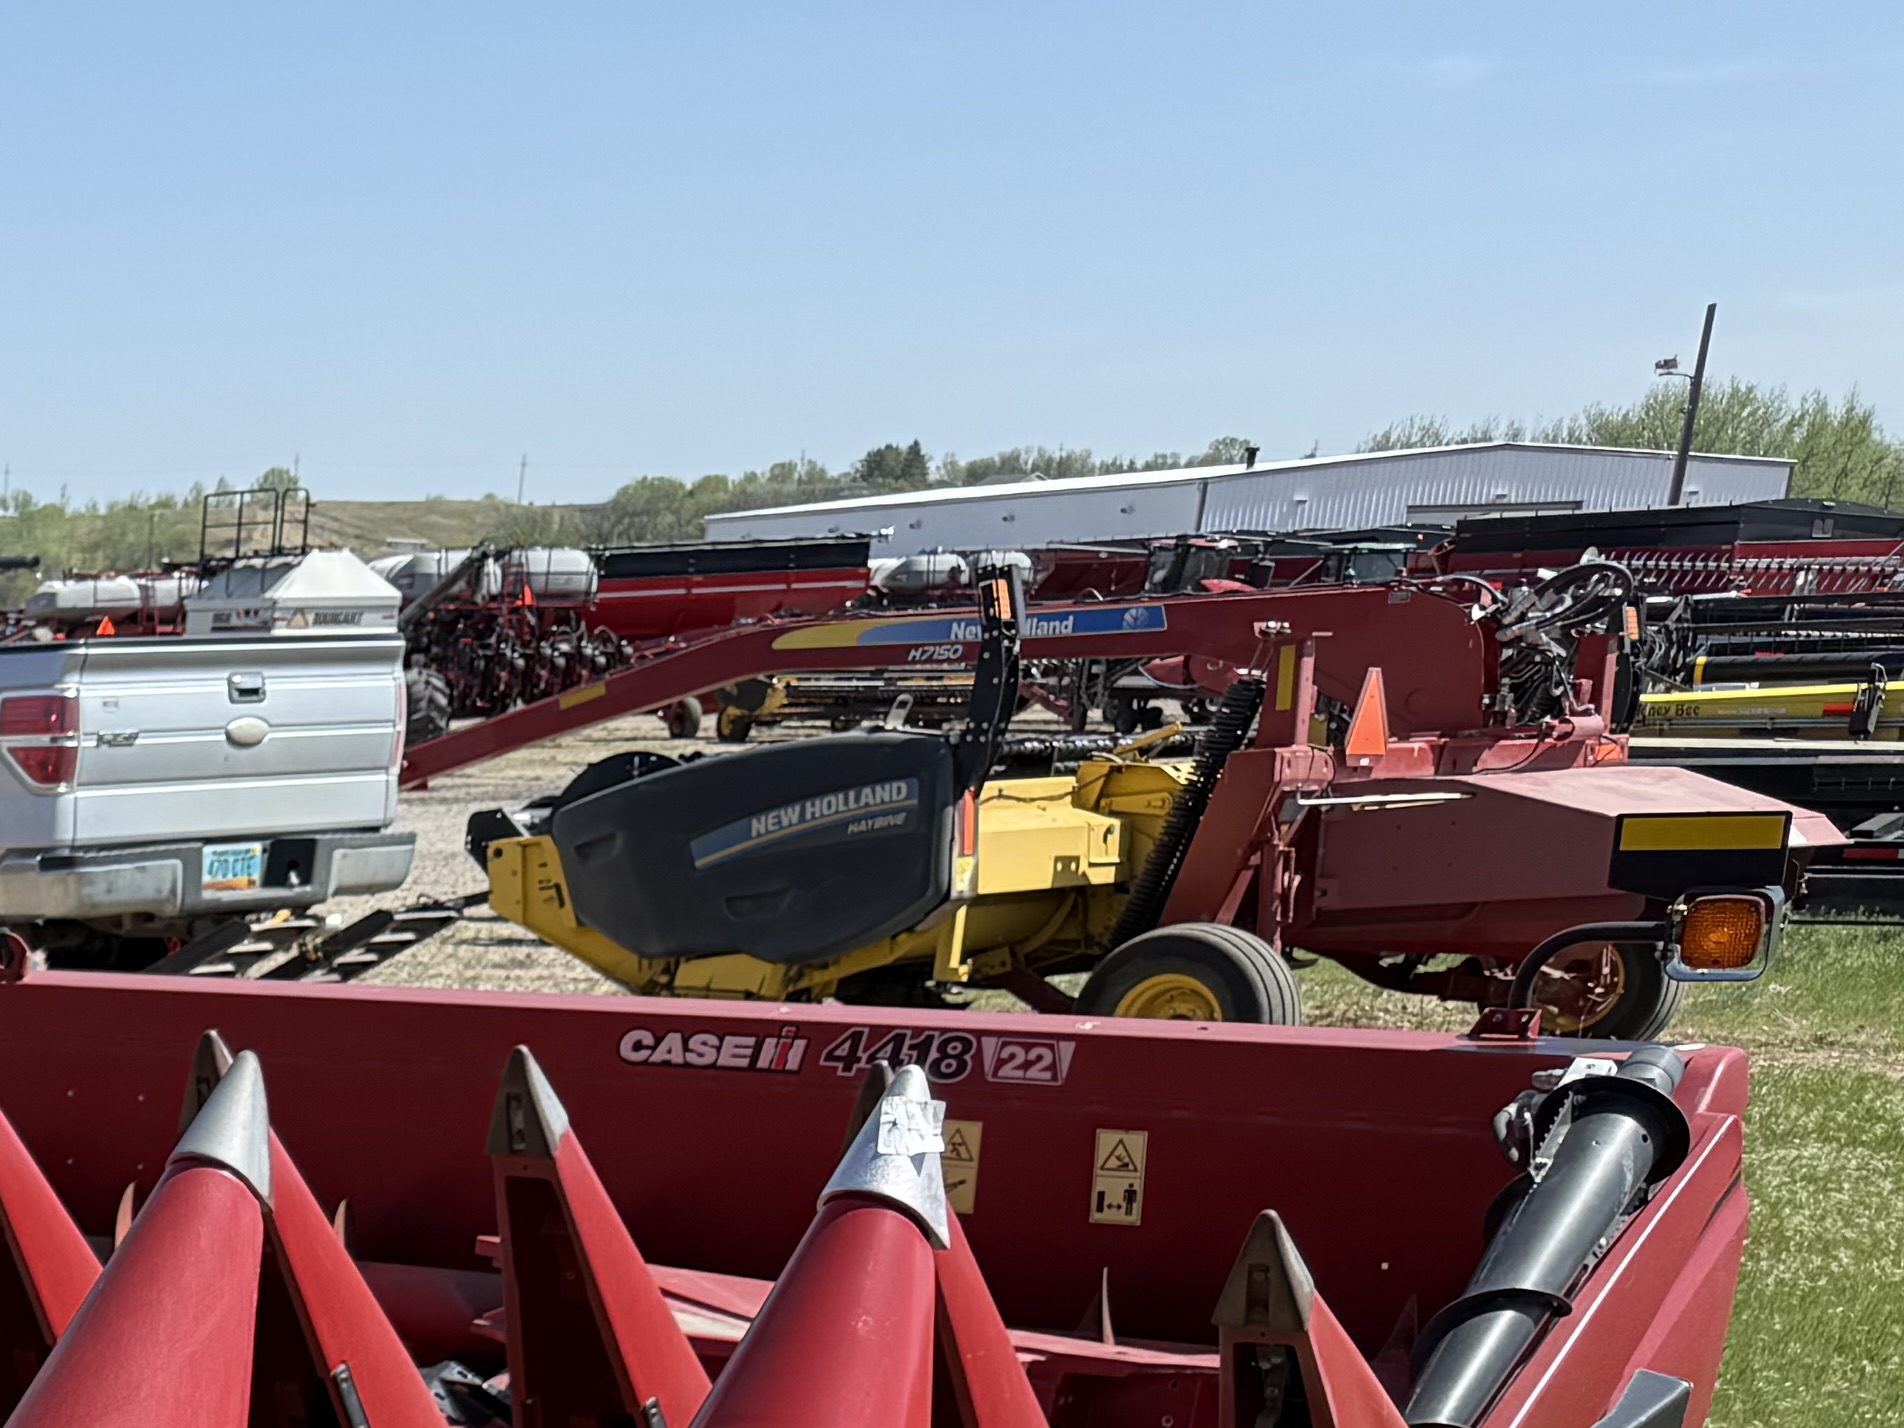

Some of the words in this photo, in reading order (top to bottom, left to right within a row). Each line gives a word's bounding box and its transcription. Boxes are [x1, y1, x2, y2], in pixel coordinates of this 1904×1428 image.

[750, 804, 801, 838] NEW
[804, 781, 908, 819] HOLLAND
[847, 812, 907, 835] HAYBINE
[819, 1027, 974, 1084] 4418
[997, 1045, 1054, 1081] 22
